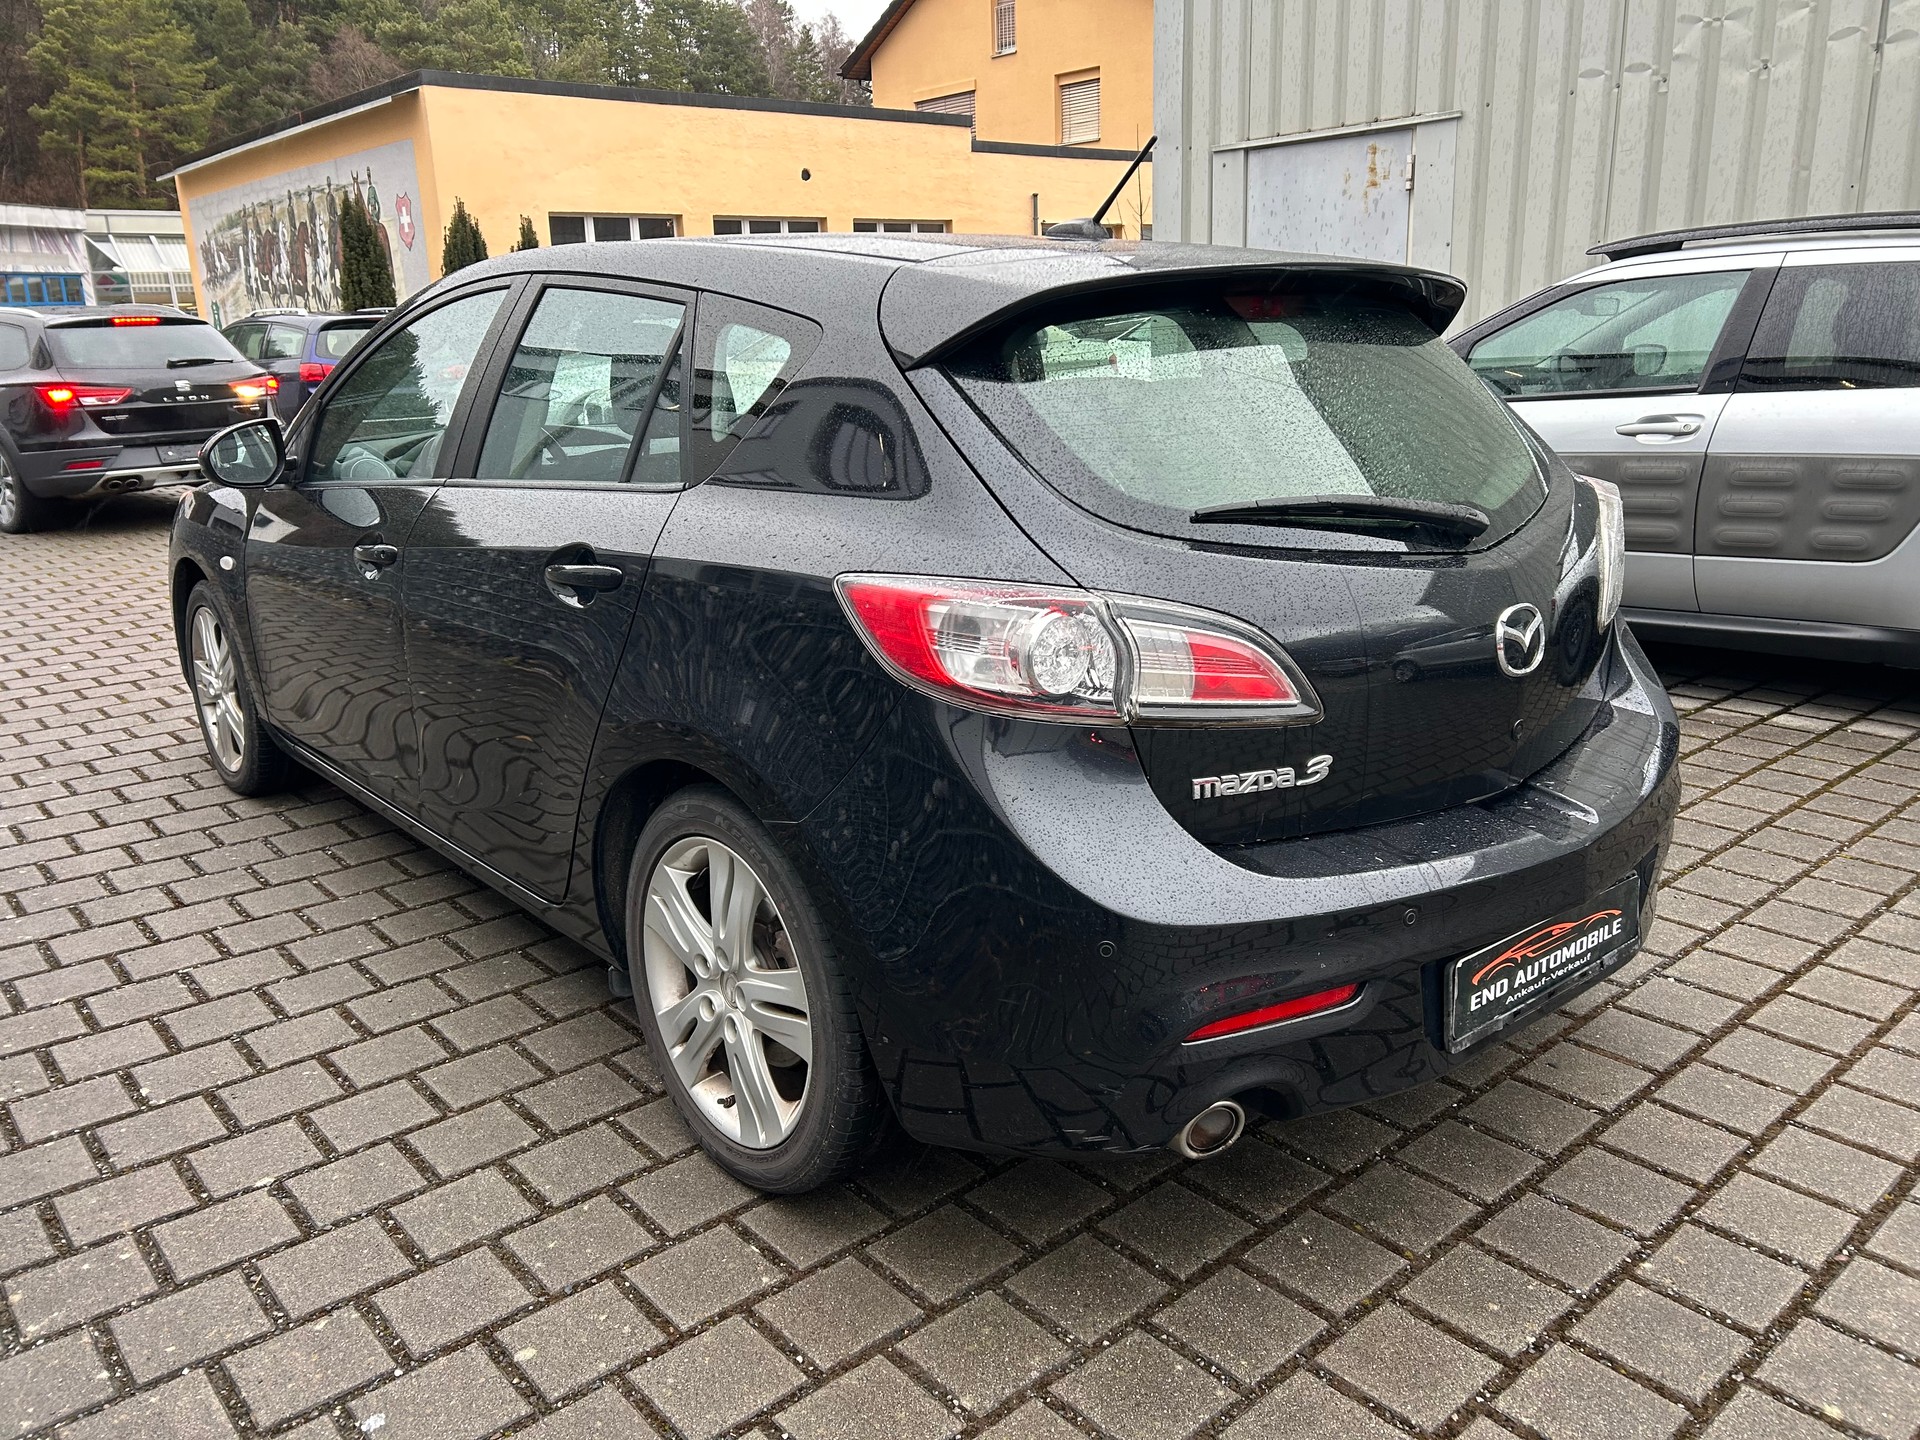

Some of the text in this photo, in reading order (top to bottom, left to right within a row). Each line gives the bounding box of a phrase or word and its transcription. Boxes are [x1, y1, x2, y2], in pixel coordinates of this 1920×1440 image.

[162, 394, 210, 402] LEON
[1470, 917, 1622, 1011] END AUTOMOBILE
[1505, 952, 1592, 1005] Ankauf-Verkauf
